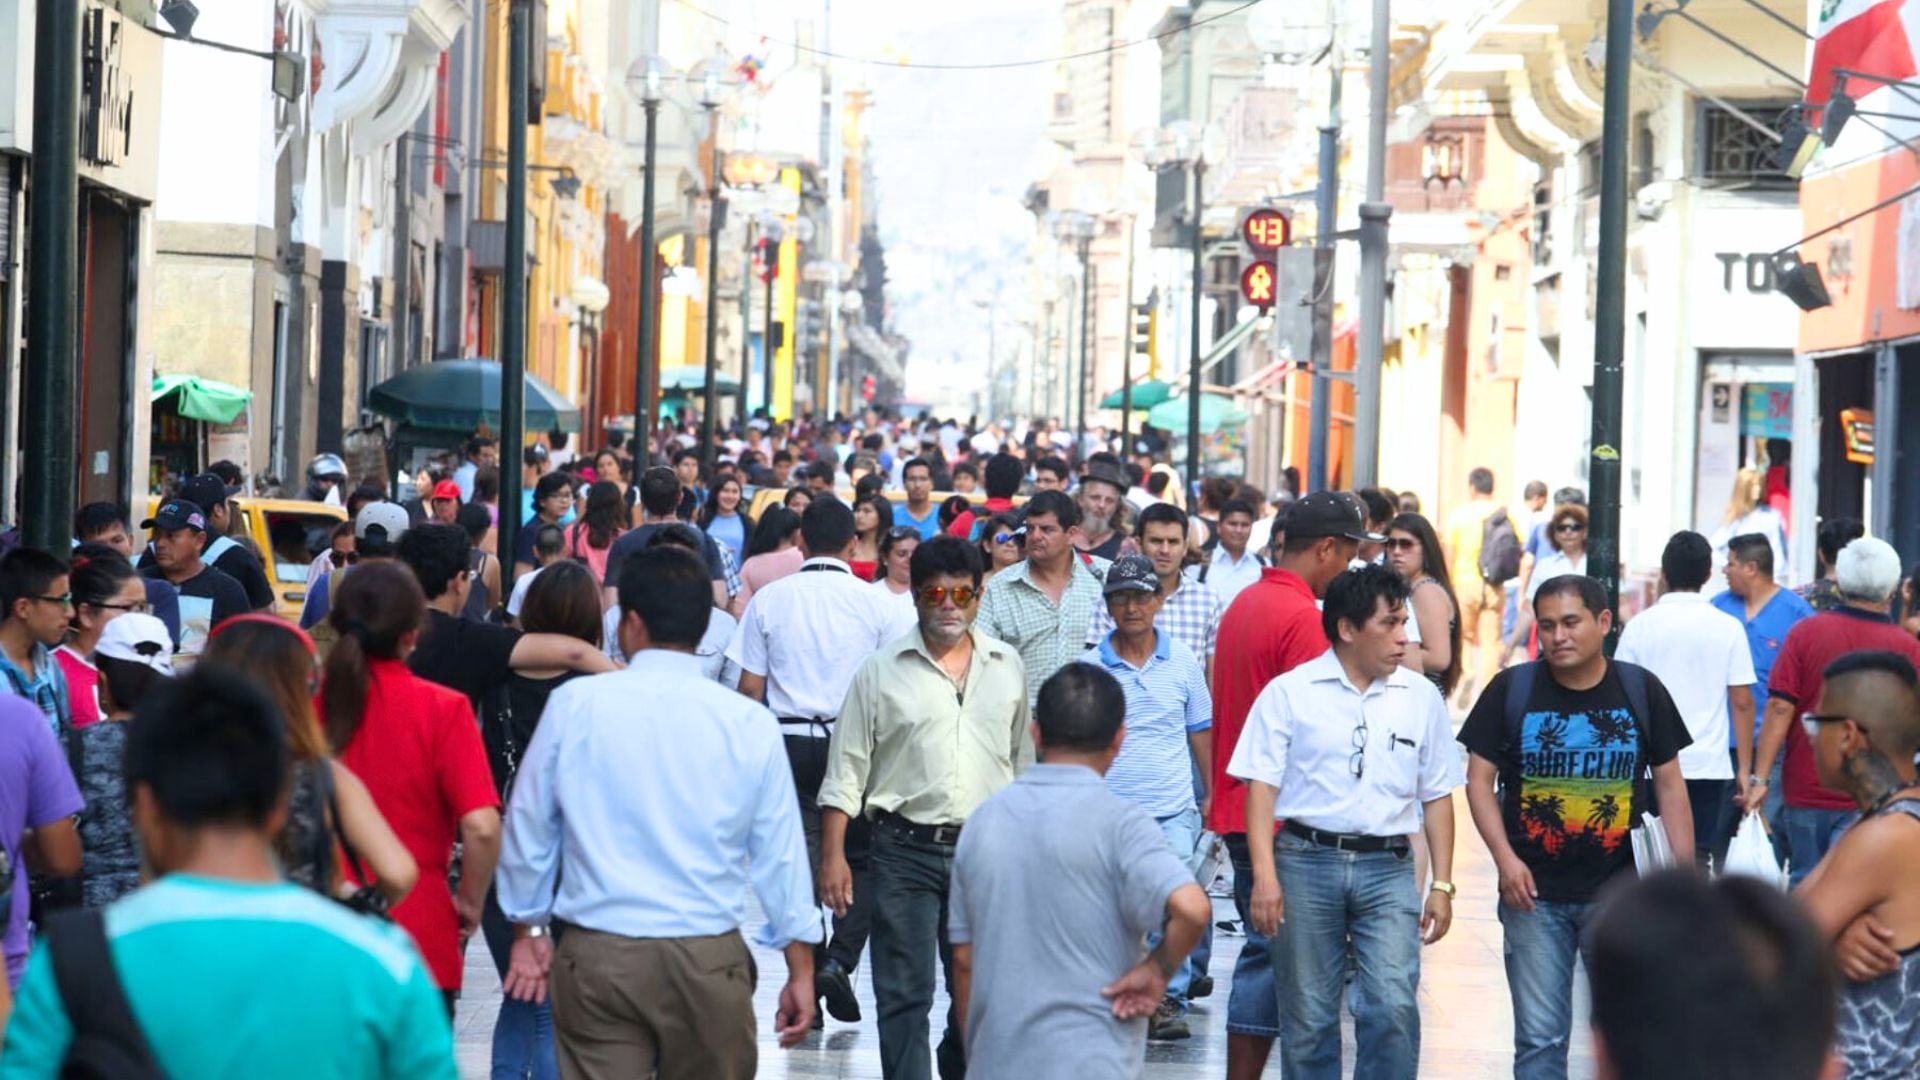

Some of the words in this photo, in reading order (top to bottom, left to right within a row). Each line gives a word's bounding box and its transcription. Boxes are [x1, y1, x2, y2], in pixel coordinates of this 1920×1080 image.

[1250, 218, 1282, 245] 43
[1523, 751, 1580, 778] SURF
[1582, 751, 1634, 779] CLUB
